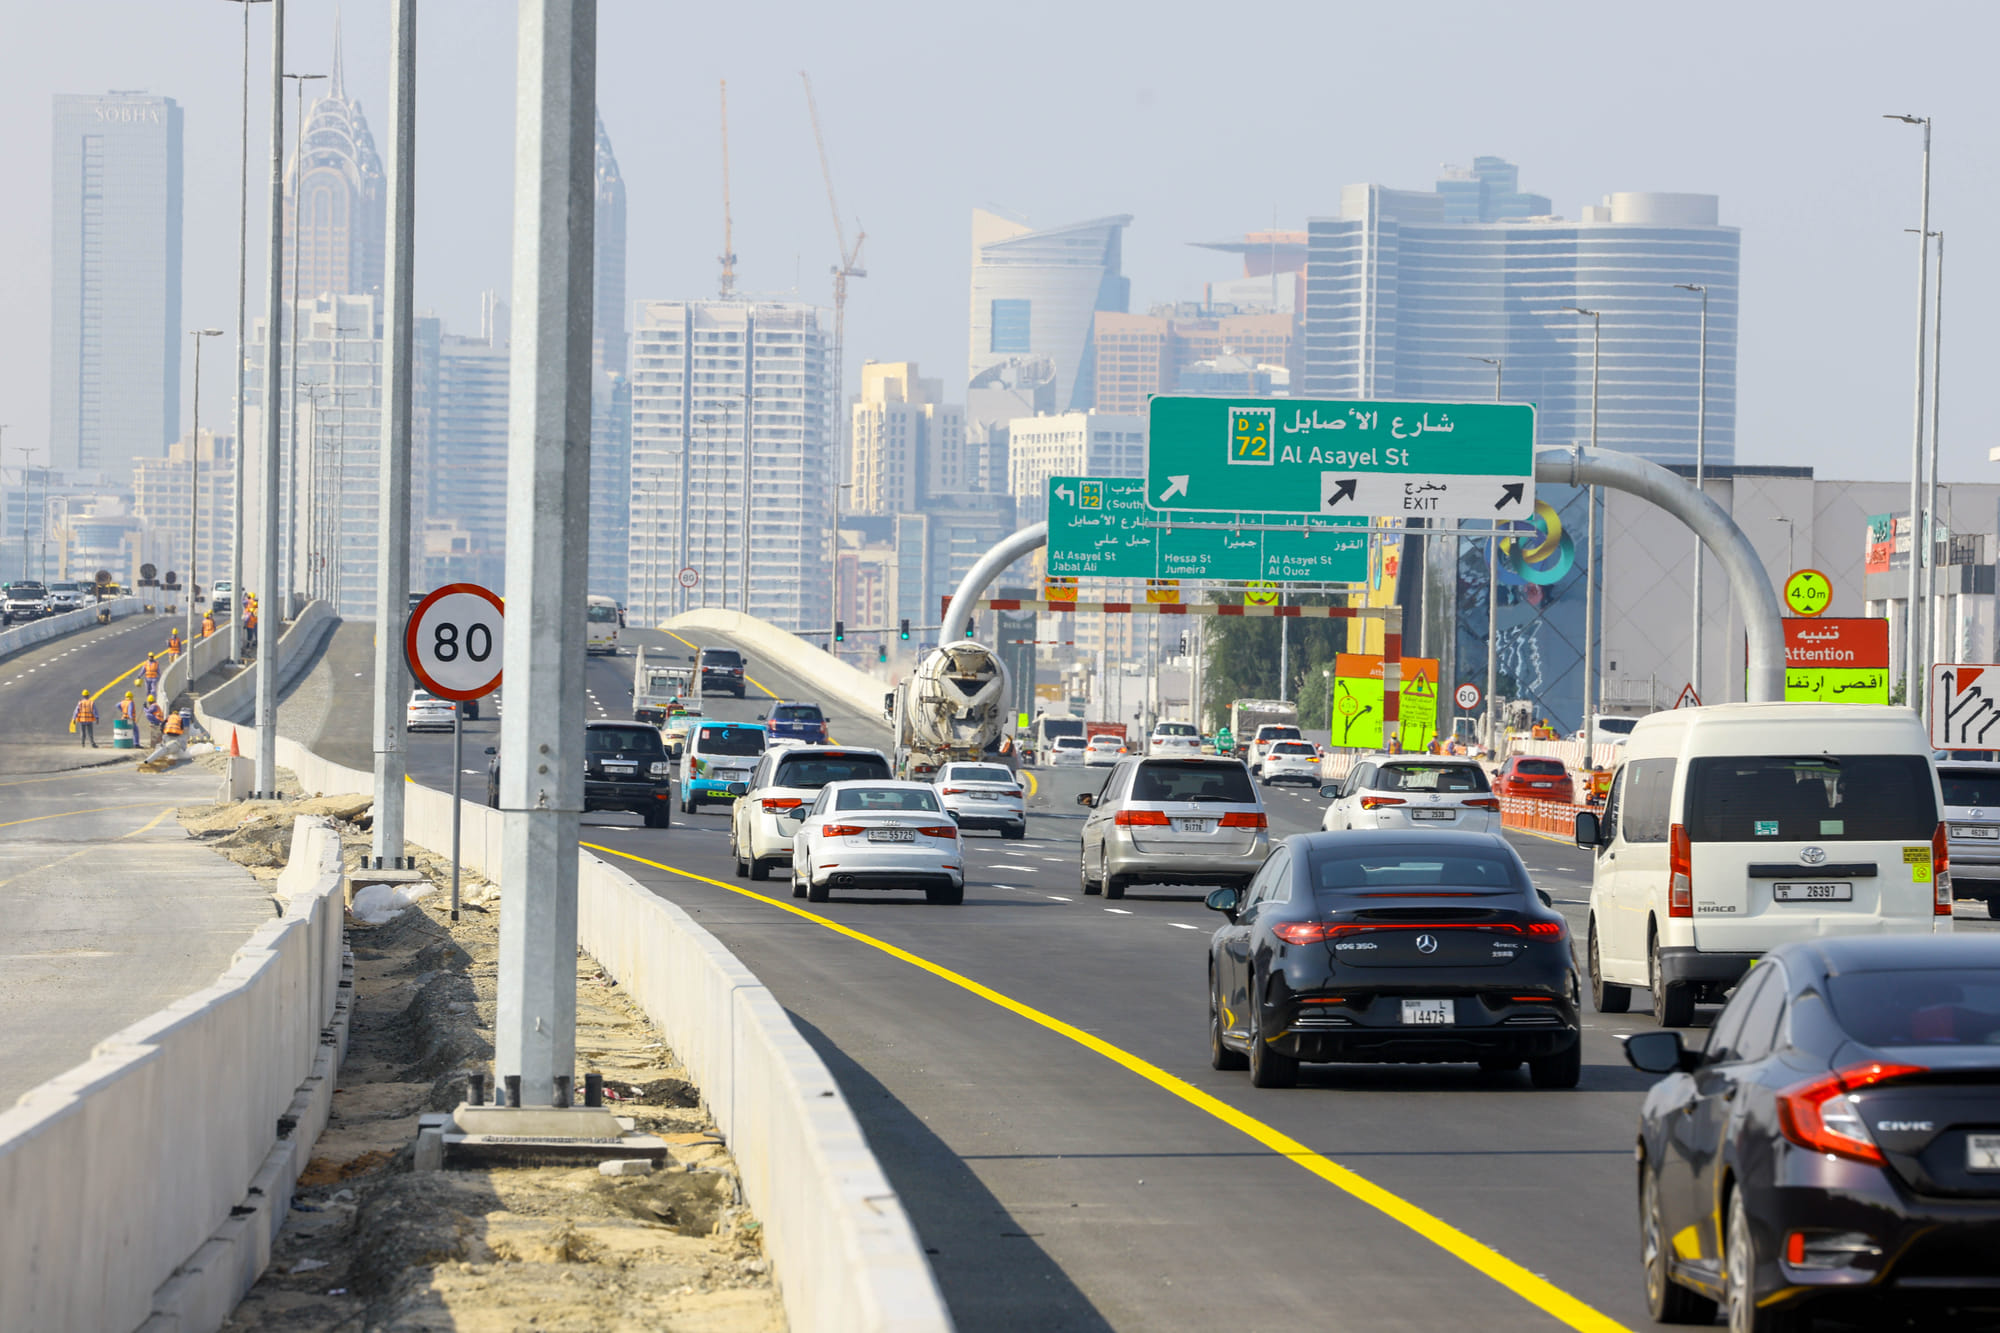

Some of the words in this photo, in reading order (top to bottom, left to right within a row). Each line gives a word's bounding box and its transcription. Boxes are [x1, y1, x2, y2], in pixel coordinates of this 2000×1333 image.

[95, 107, 160, 124] SOBHA
[1238, 419, 1249, 431] D
[1390, 411, 1455, 438] شارع
[1236, 436, 1267, 456] 72
[1280, 445, 1302, 465] Al
[1309, 447, 1378, 469] Asayel
[1385, 447, 1409, 466] St
[1404, 480, 1448, 495] مخرج
[1083, 496, 1100, 507] 72
[1403, 496, 1439, 510] EXIT
[1125, 534, 1151, 548] جبل
[1224, 535, 1257, 549] جميرا
[1334, 538, 1364, 551] القوز
[1053, 551, 1064, 560] Al
[1067, 551, 1101, 561] Asayel
[1104, 551, 1116, 561] St
[1164, 554, 1197, 563] Hessa
[1200, 554, 1212, 563] St
[1269, 555, 1280, 564] Al
[1282, 555, 1317, 566] Asayel
[1320, 556, 1332, 565] St
[1053, 562, 1080, 571] Jabal
[1083, 562, 1097, 571] Ali
[1164, 565, 1206, 574] Jumeira
[1269, 566, 1280, 575] Al
[1283, 566, 1310, 576] Quoz
[1797, 625, 1840, 644] تنبيه
[434, 622, 492, 662] 80
[1784, 647, 1854, 661] Attention
[1459, 692, 1476, 703] 60
[1807, 885, 1836, 898] 26397
[1697, 905, 1737, 913] HIACE
[1413, 1010, 1445, 1024] 14475
[1877, 1120, 1933, 1131] CIVIC
